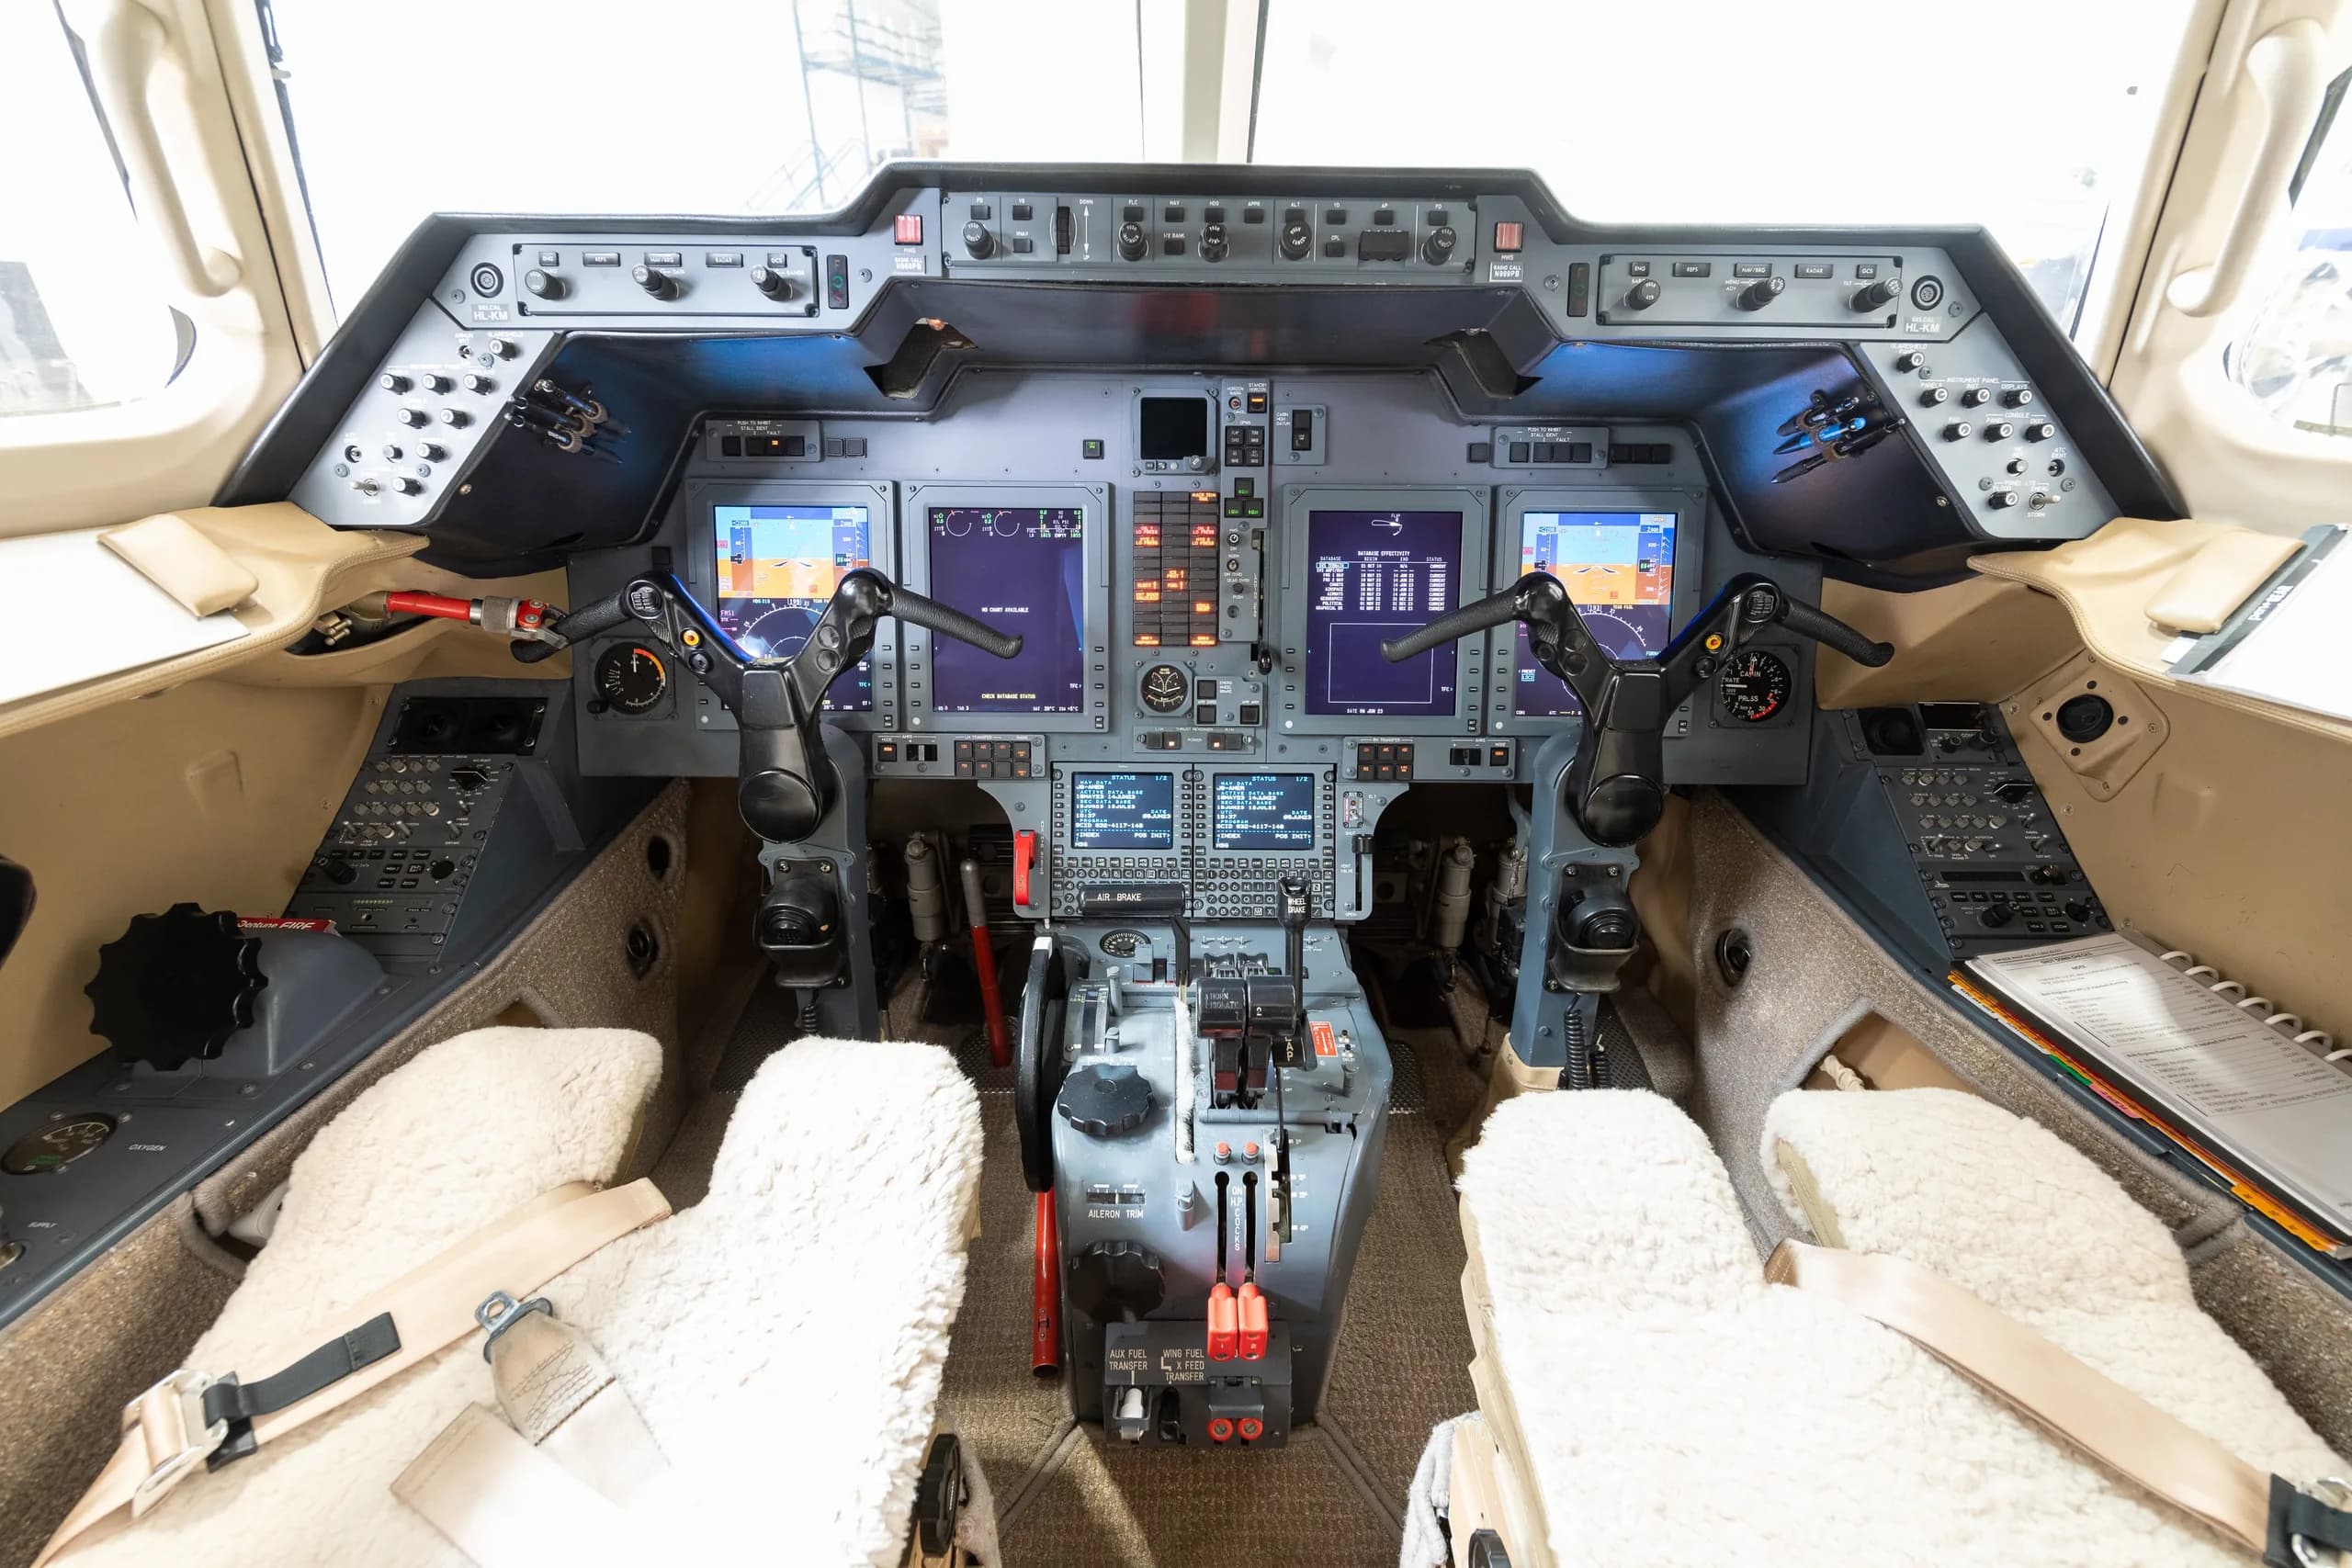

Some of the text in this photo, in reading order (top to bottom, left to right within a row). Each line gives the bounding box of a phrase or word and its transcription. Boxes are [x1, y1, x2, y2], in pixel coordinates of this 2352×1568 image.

[473, 310, 508, 322] HL-KM
[1905, 322, 1940, 333] HL-KM
[1096, 893, 1142, 902] AIR BRAKE
[1287, 897, 1306, 906] WHEEL
[1231, 1186, 1243, 1195] ON
[1088, 1209, 1144, 1219] AILERON TRIM
[1110, 1348, 1148, 1359] AUX FUEL
[1162, 1348, 1204, 1359] WING FUEL
[1109, 1360, 1148, 1371] TRANSFER
[1184, 1360, 1204, 1371] FEED
[1165, 1371, 1204, 1382] TRANSFER
